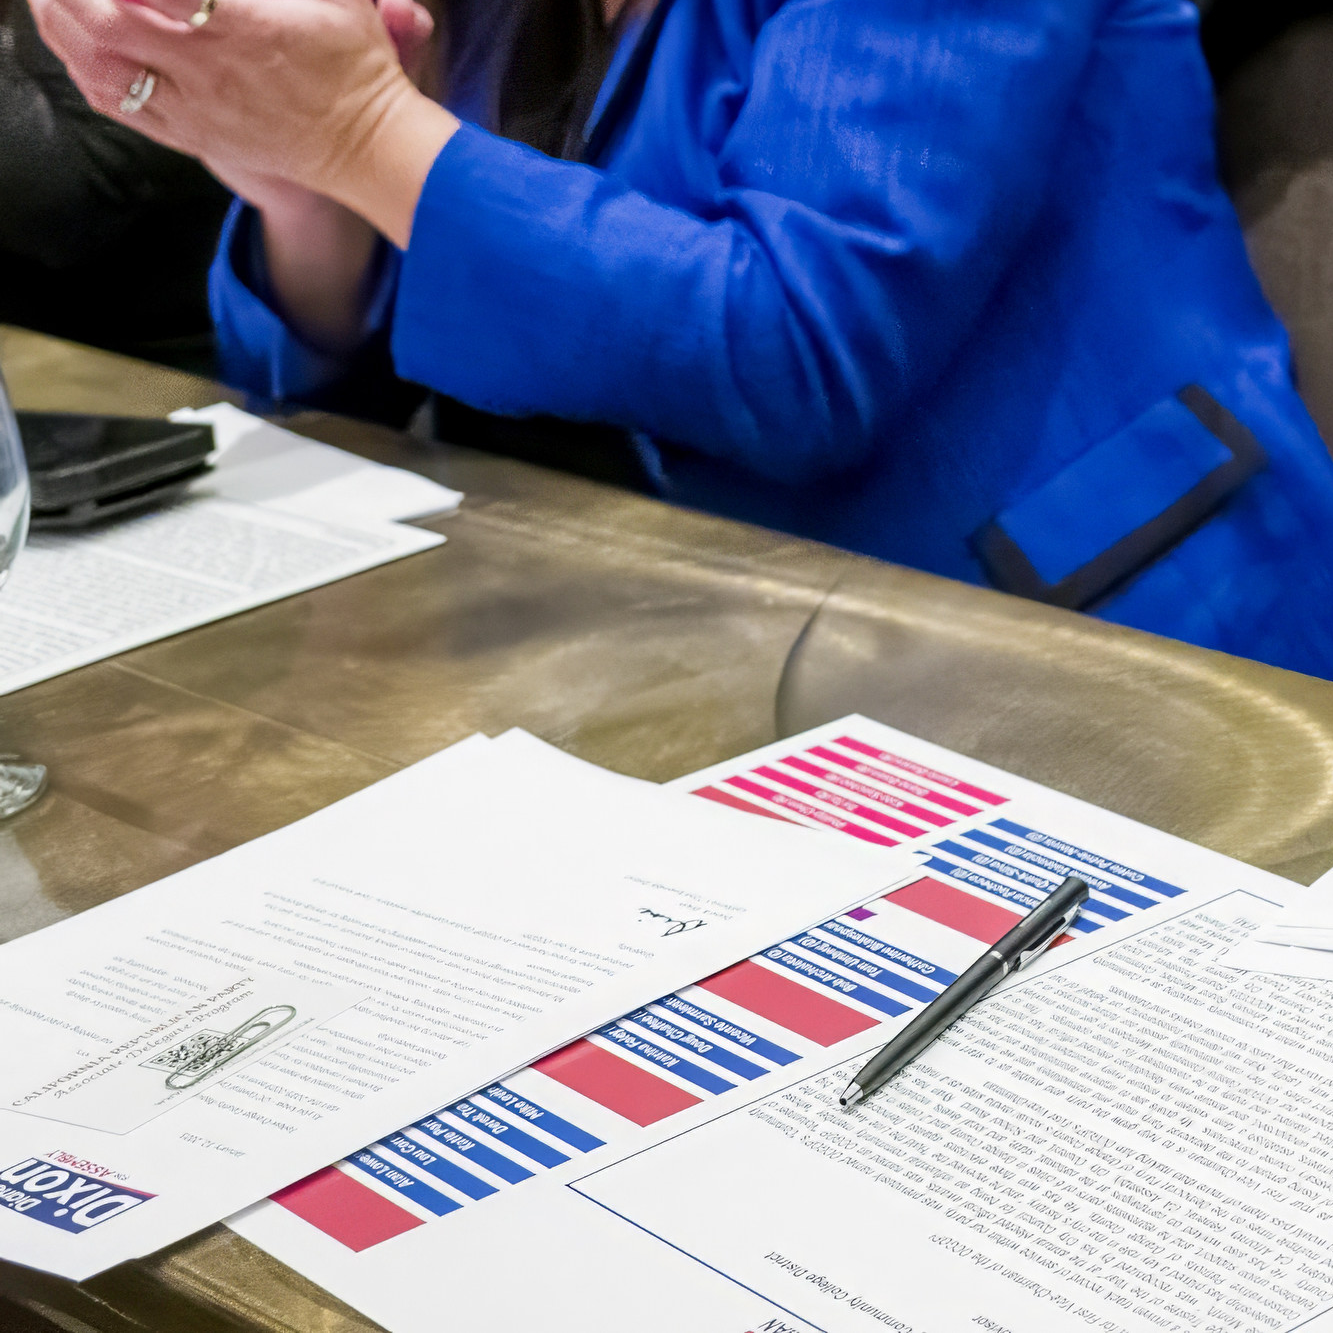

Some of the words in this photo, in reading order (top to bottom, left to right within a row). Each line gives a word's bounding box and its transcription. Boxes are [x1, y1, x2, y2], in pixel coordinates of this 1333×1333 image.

[856, 961, 884, 979] Tom
[831, 977, 859, 993] Bob
[608, 1027, 648, 1049] Foley
[639, 1014, 685, 1040] Chaffee
[713, 1021, 758, 1047] Vicente
[637, 1042, 681, 1068] Katrina
[678, 1033, 714, 1054] Doug
[53, 1060, 123, 1100] Associate
[513, 1100, 545, 1121] Mike
[471, 1111, 509, 1135] Derek
[443, 1130, 476, 1152] Katie
[43, 1150, 115, 1178] ASSEMBLY
[411, 1148, 438, 1167] Lou
[384, 1169, 416, 1189] Alan
[0, 1158, 143, 1228] Dixon
[763, 1251, 809, 1278] District
[805, 1273, 849, 1301] College
[1000, 1268, 1075, 1312] Vice-Chairman
[1071, 1306, 1102, 1325] First
